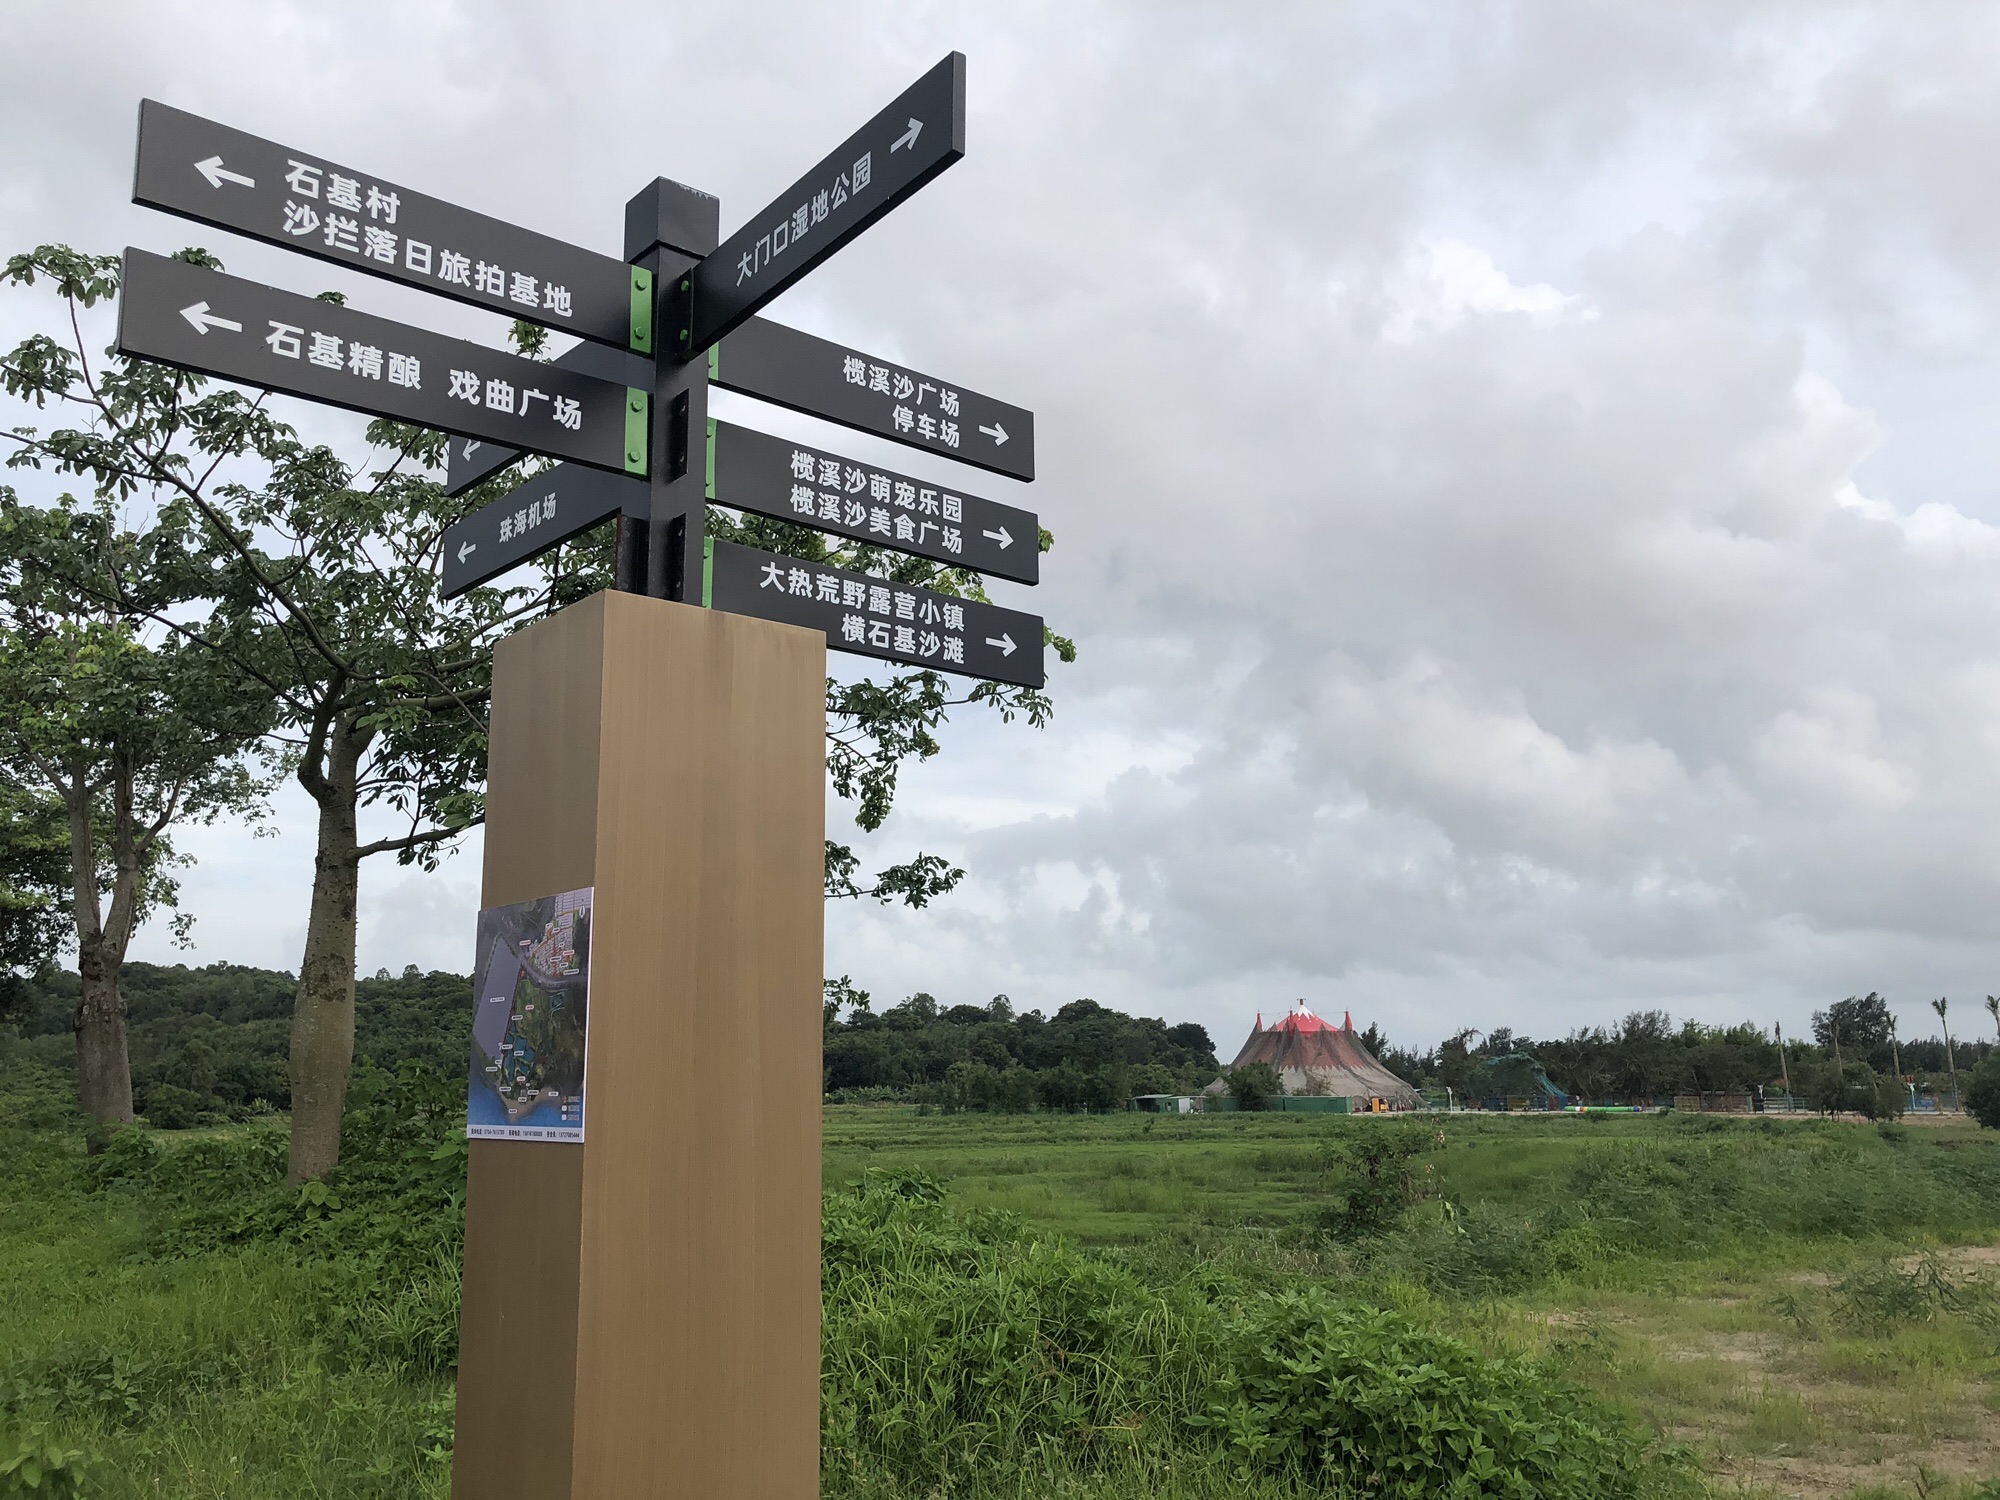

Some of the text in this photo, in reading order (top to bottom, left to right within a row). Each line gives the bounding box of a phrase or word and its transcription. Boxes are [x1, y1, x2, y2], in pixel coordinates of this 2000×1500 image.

[284, 158, 400, 225] 石基村
[736, 151, 871, 287] 大门口湿地公园
[282, 199, 573, 318] 沙拦落日旅拍基地
[265, 319, 582, 430] 石基精酿 戏曲广场
[842, 354, 960, 418] 榄溪沙广场
[891, 403, 960, 449] 停车场
[498, 492, 557, 543] 珠海机场
[789, 483, 963, 554] 榄溪沙美食广场
[790, 449, 962, 524] 榄溪沙萌宠乐园
[759, 561, 965, 633] 大热荒野露营小镇
[840, 612, 965, 665] 横石基沙滩
